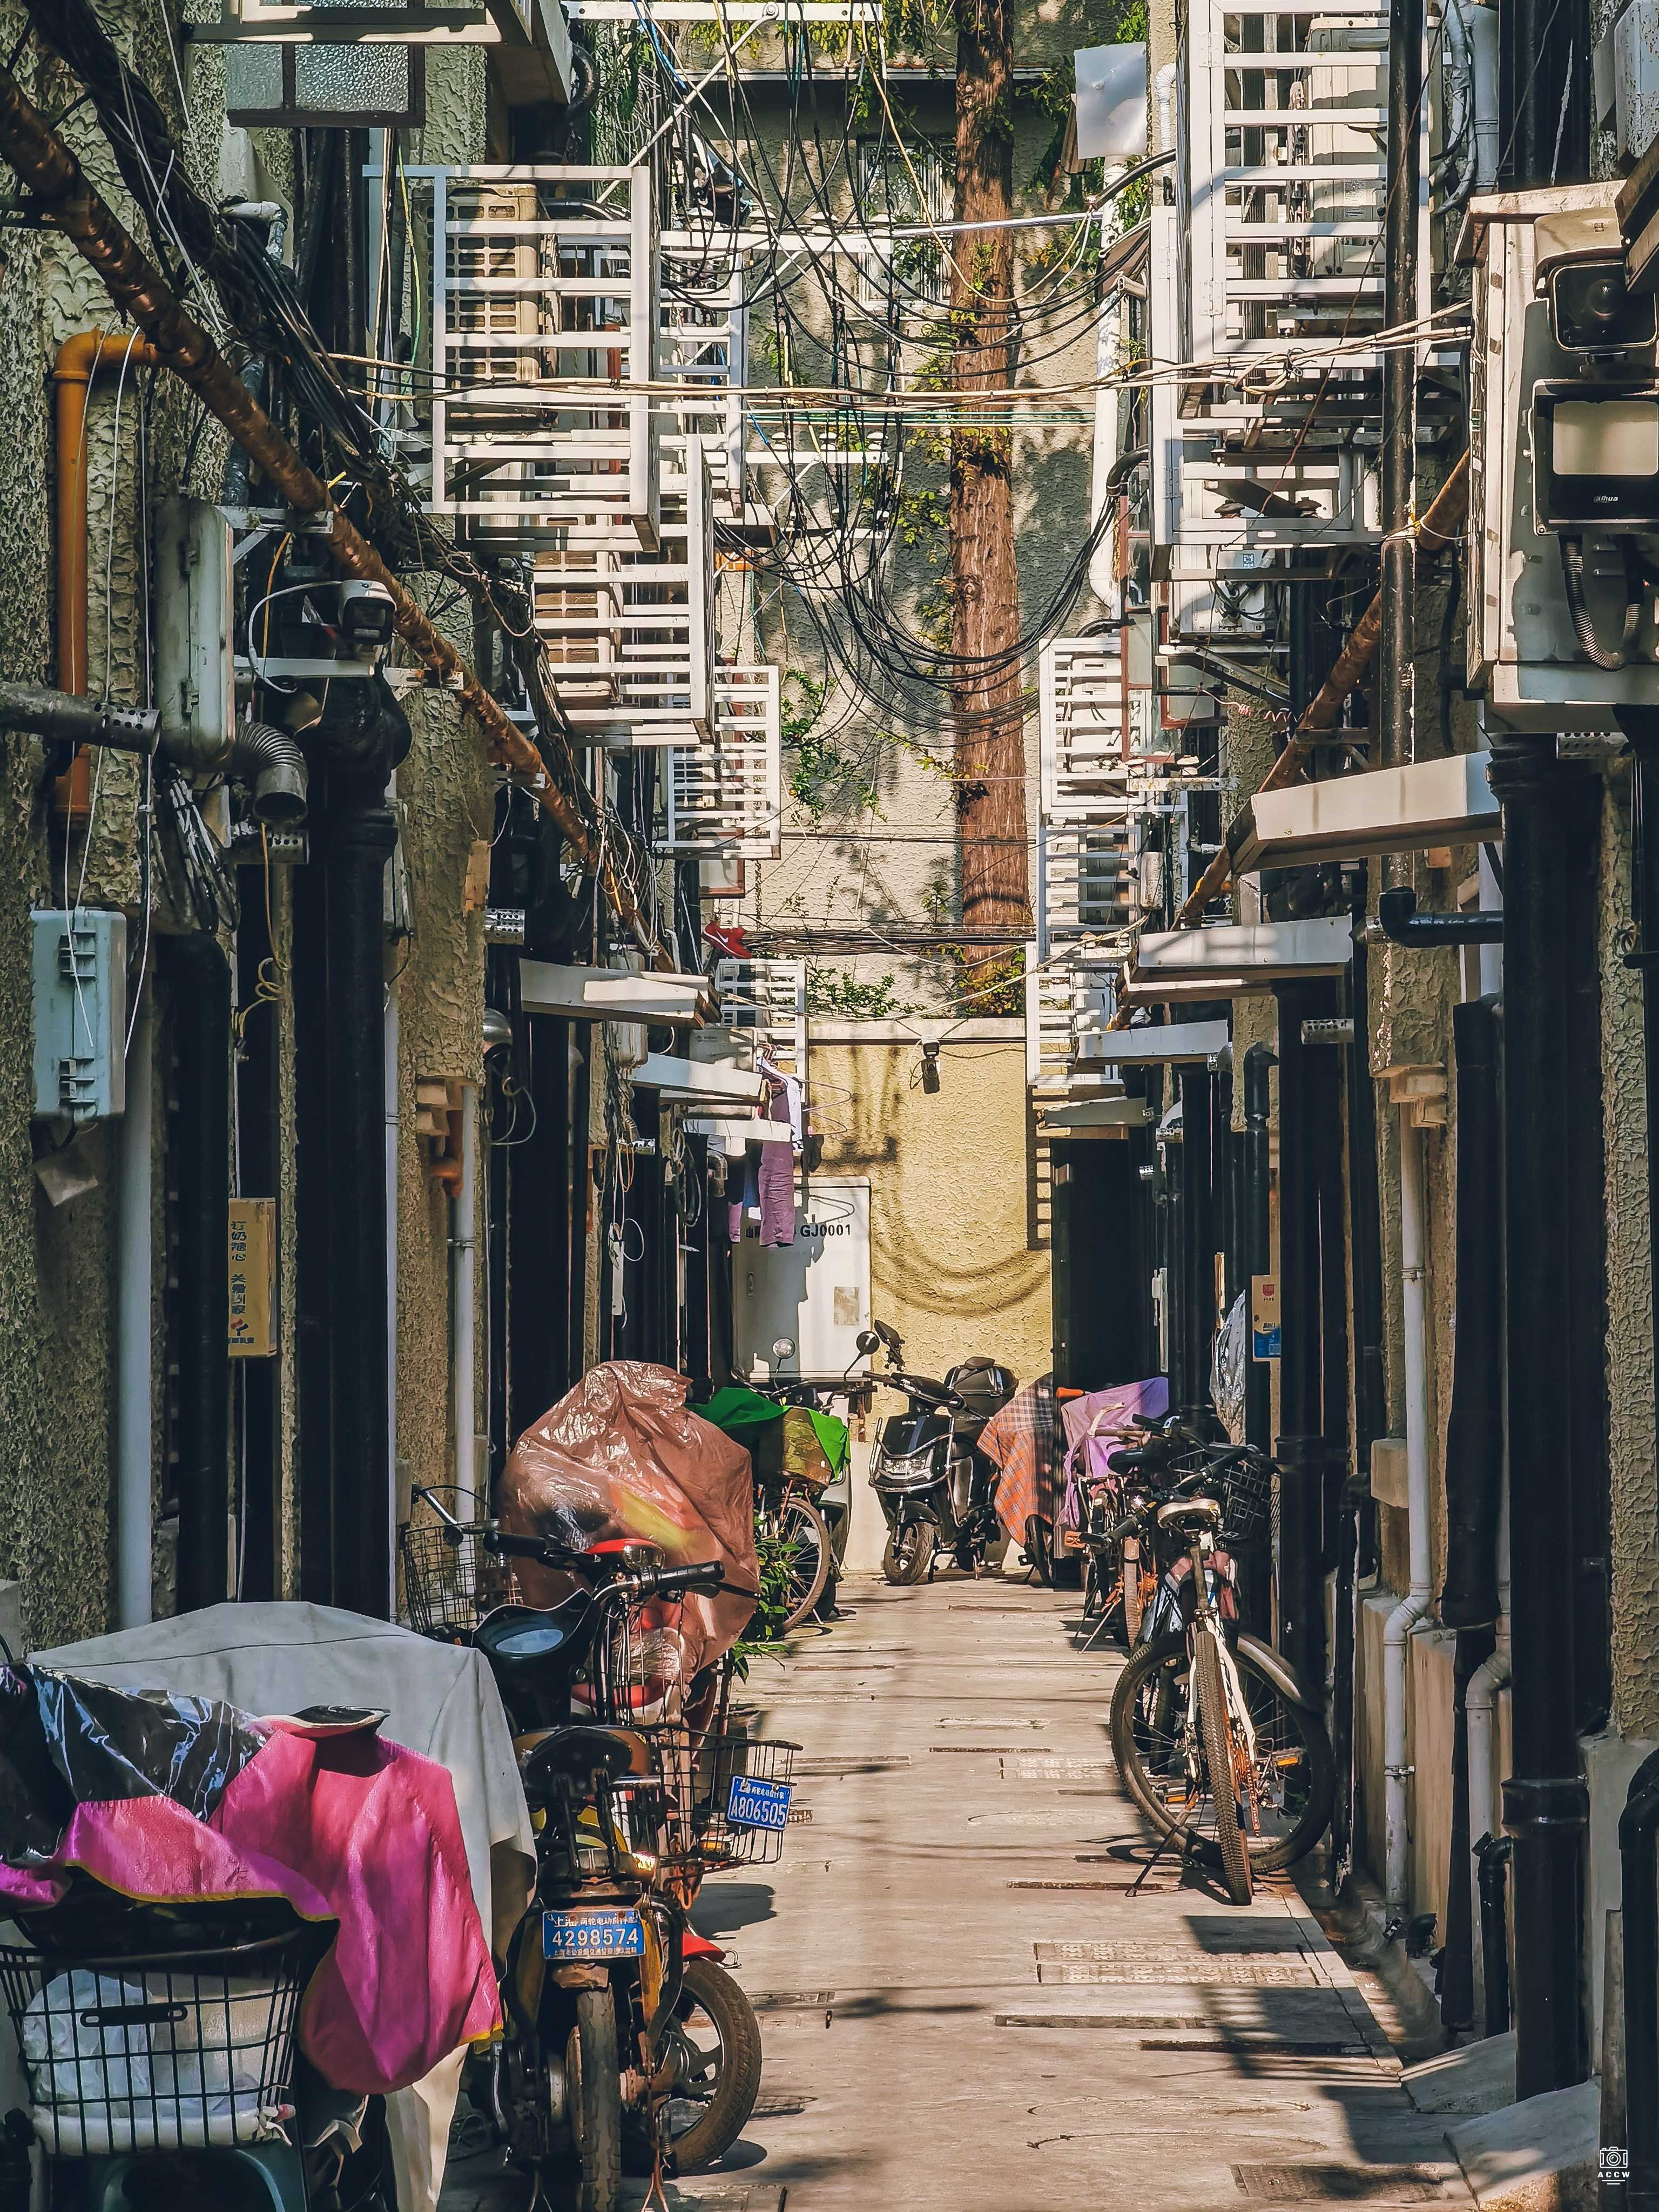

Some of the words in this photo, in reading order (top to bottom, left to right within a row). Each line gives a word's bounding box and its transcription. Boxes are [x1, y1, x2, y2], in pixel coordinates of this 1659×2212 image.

[800, 1224, 851, 1237] GJ0001
[731, 1795, 787, 1826] A806505
[552, 1928, 638, 1946] 4298574
